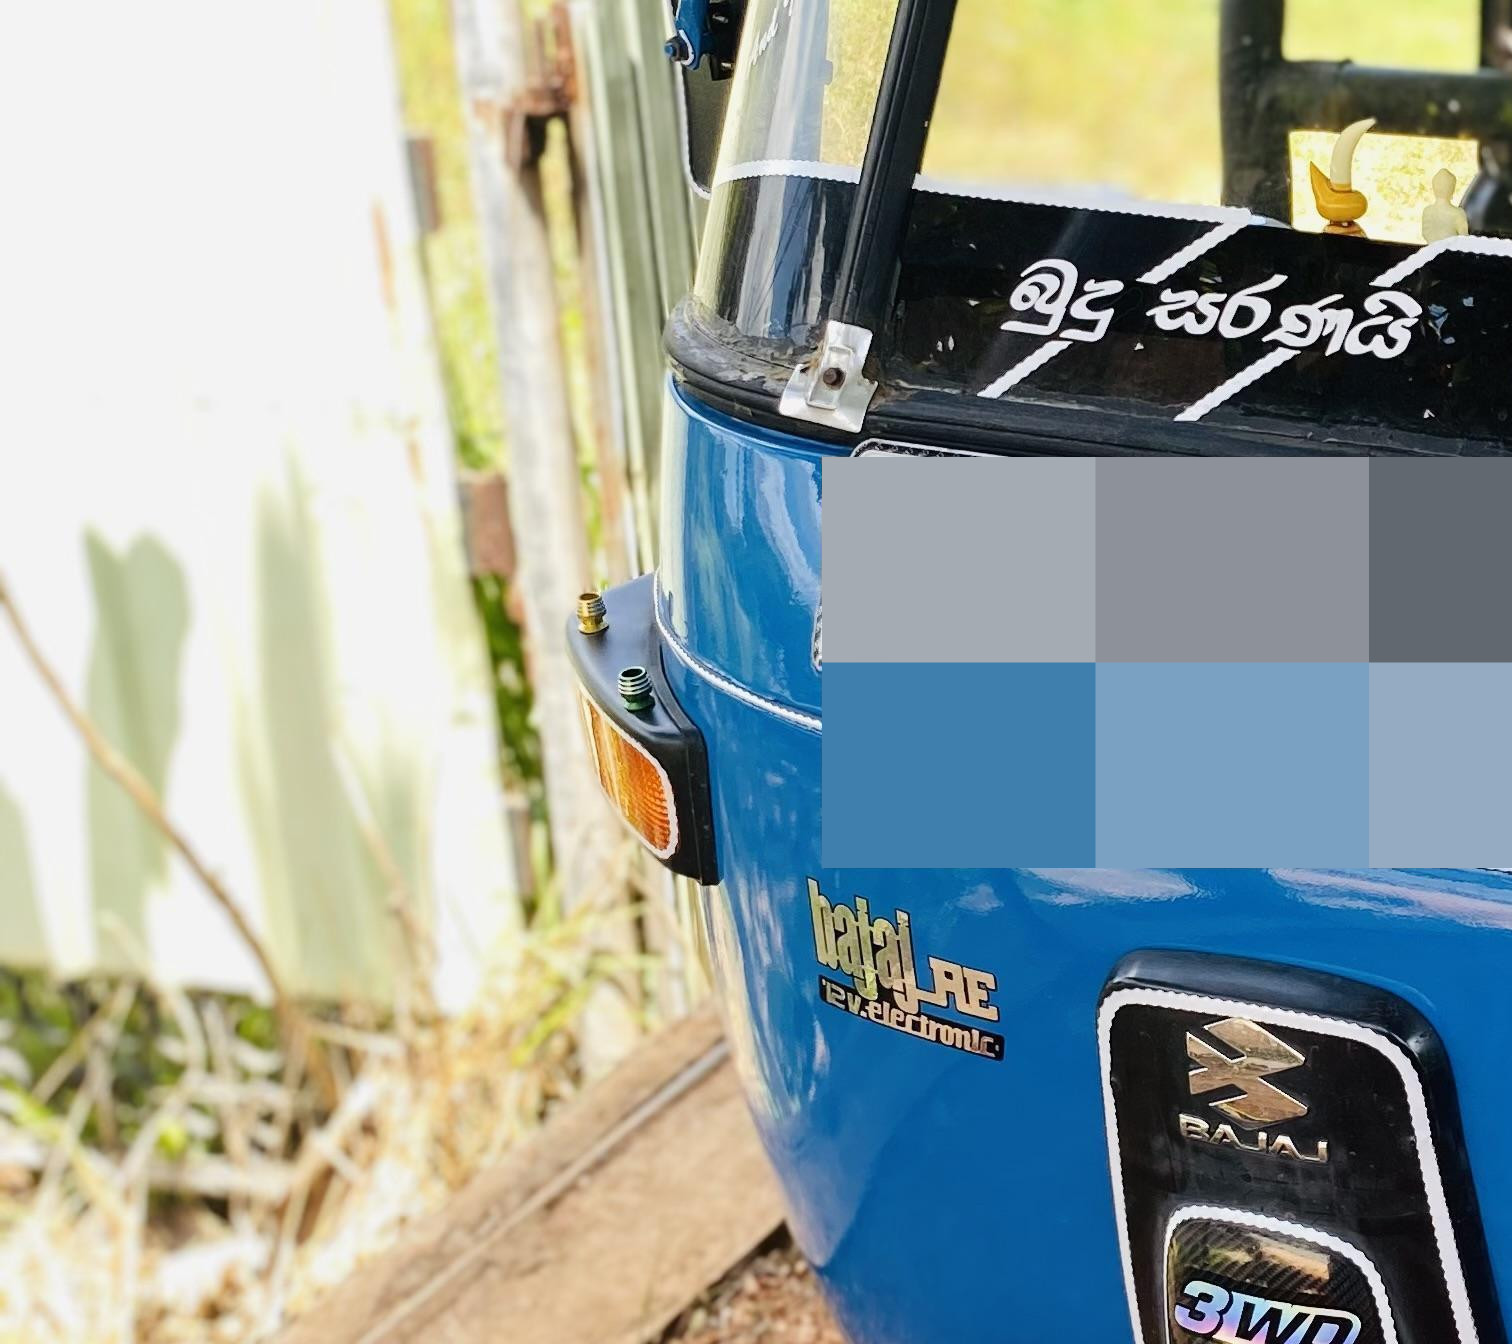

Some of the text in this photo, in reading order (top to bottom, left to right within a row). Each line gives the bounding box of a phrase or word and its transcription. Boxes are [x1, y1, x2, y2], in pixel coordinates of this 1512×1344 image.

[1000, 258, 1424, 359] බුදු සරණයි
[1178, 1113, 1329, 1164] BAJAJ
